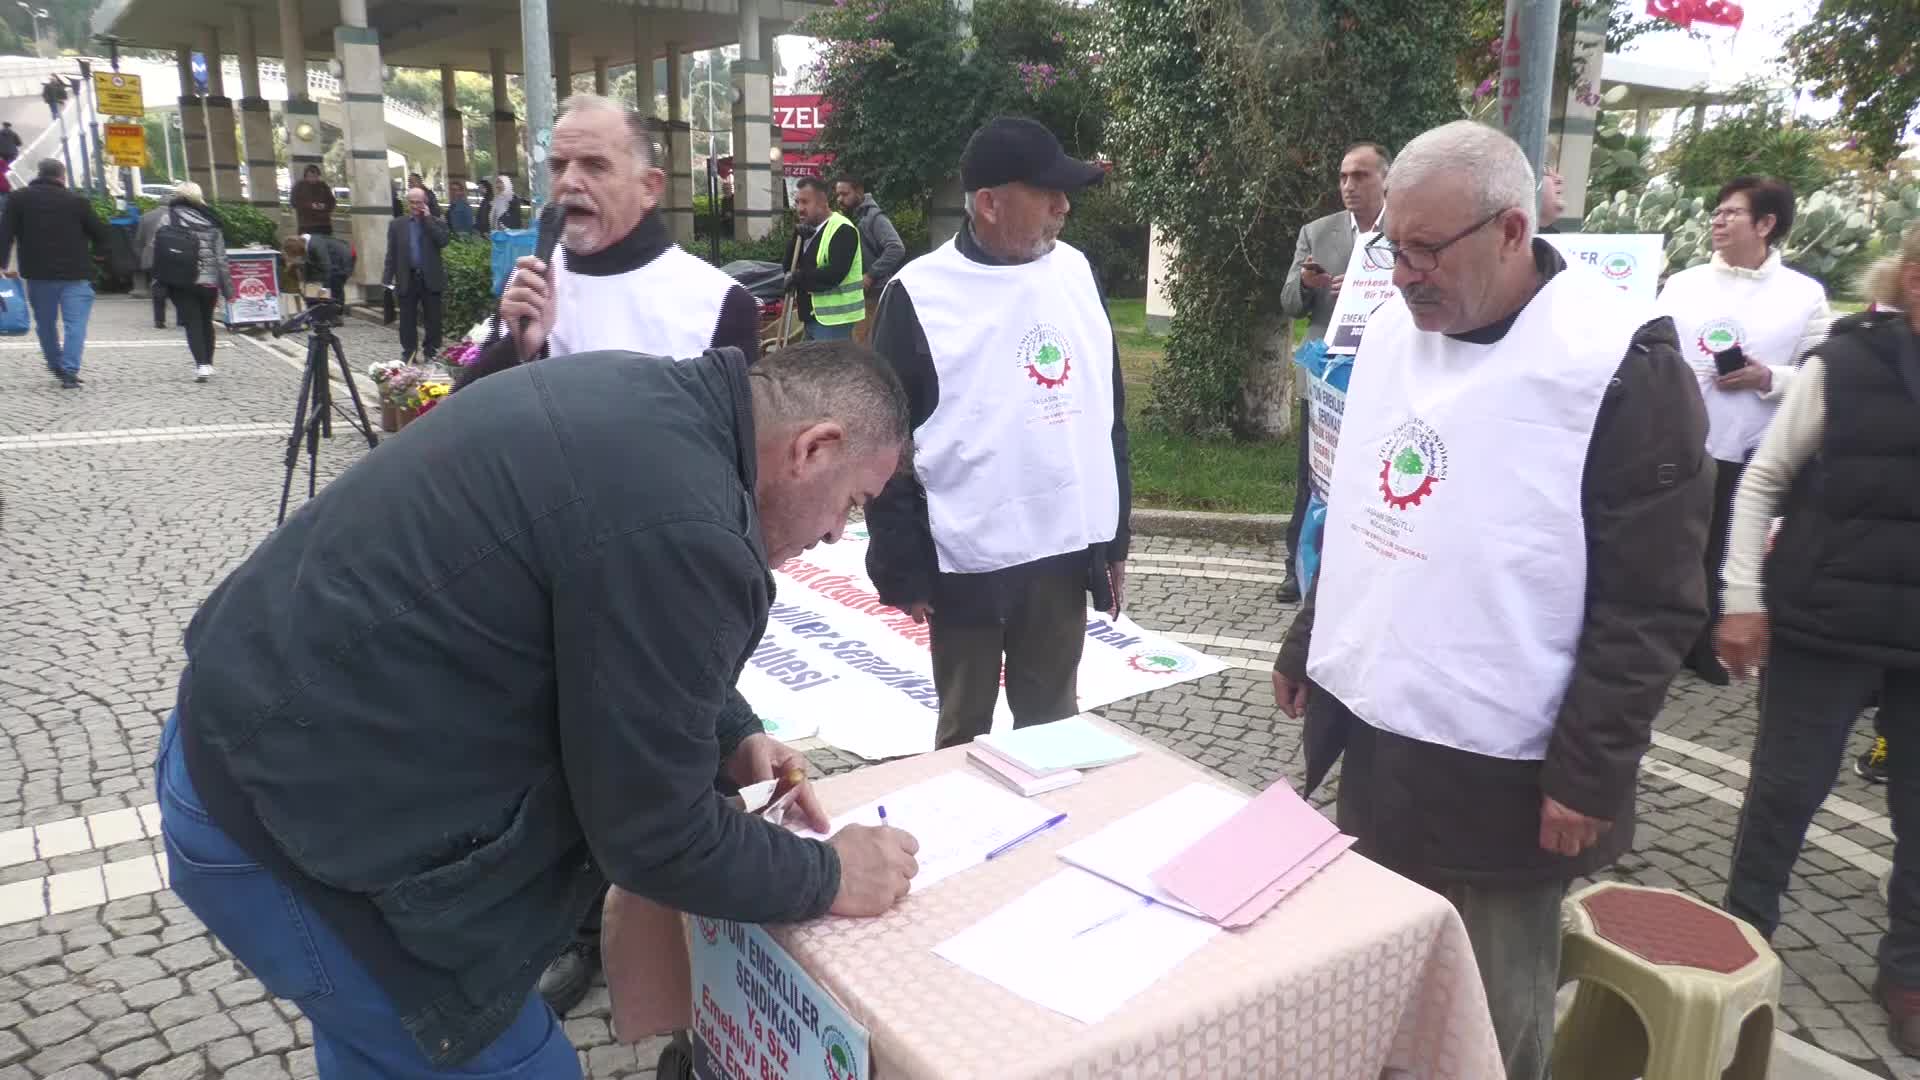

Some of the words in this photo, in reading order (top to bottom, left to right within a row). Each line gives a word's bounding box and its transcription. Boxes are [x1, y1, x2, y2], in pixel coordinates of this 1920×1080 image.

[1341, 313, 1368, 323] EMEKL
[819, 640, 942, 714] Sendikas
[702, 984, 757, 1067] Emekliyi
[736, 959, 801, 1056] SENDİKASI
[750, 936, 820, 1039] EMEKLİLER
[746, 1001, 763, 1042] Ya
[767, 1028, 789, 1072] Siz
